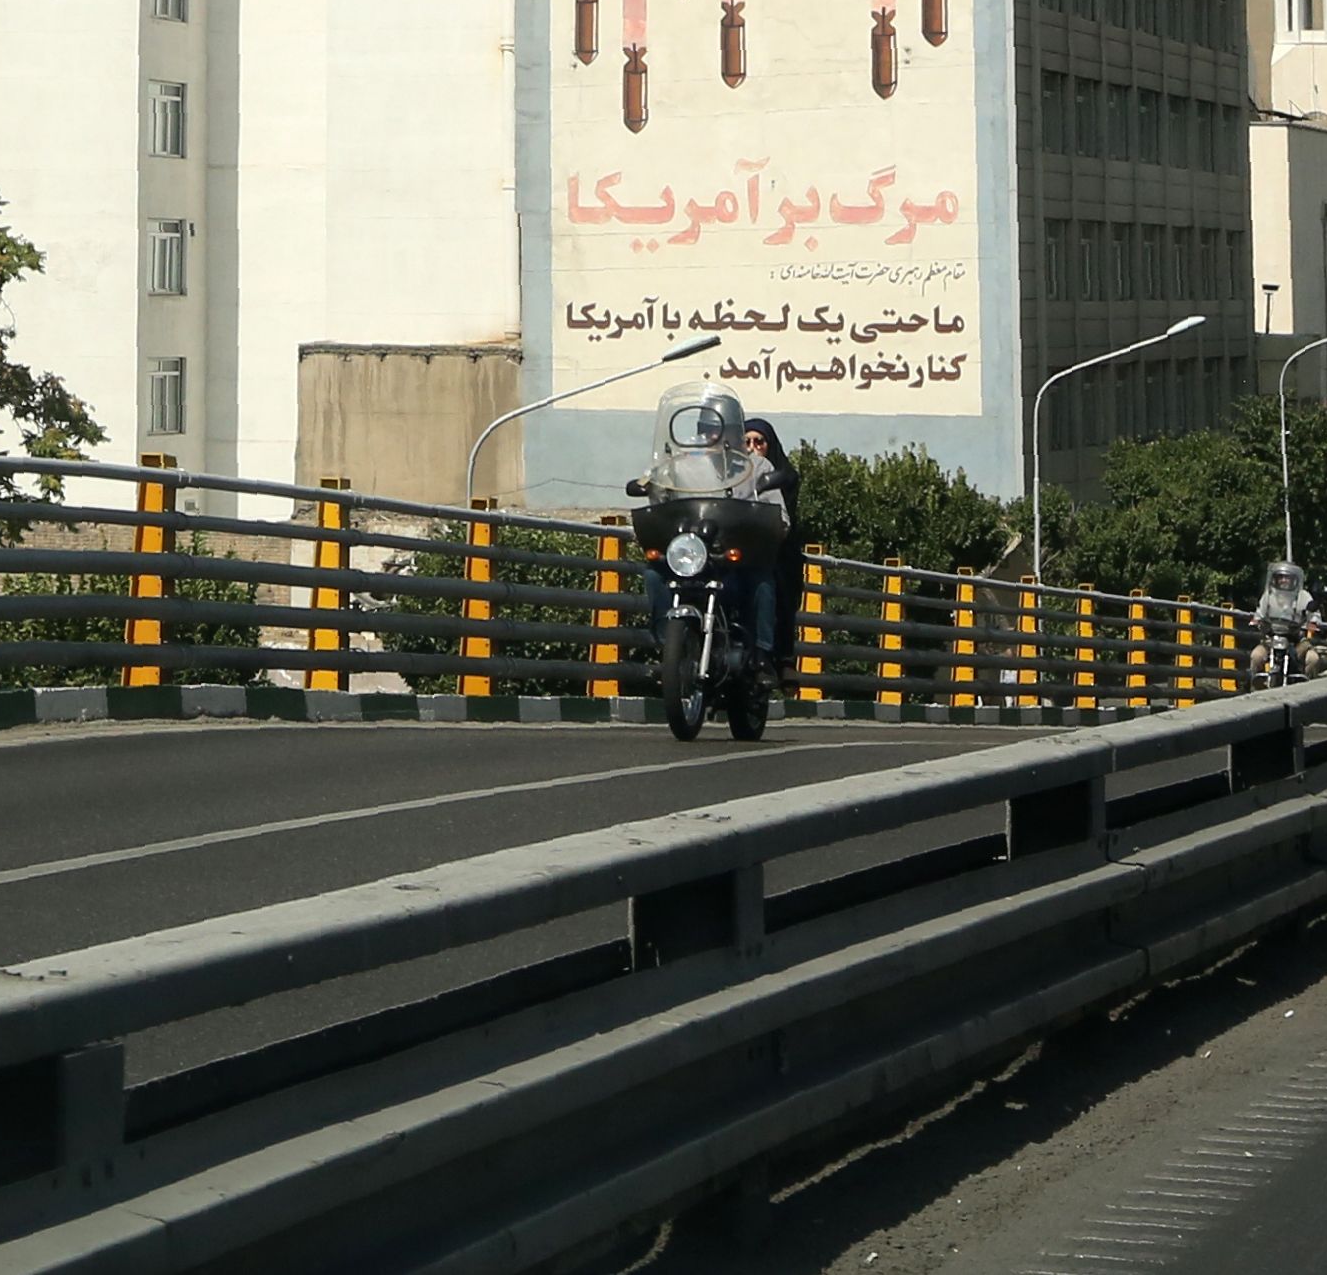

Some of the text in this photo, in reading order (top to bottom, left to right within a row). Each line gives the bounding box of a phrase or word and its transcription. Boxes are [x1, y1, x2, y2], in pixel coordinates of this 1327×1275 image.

[567, 157, 960, 253] مرگ بر آمریکا
[565, 297, 966, 346] ما حتی یک لحظه با آمریکا
[776, 351, 910, 393] نخواهیم
[907, 354, 968, 389] کنار
